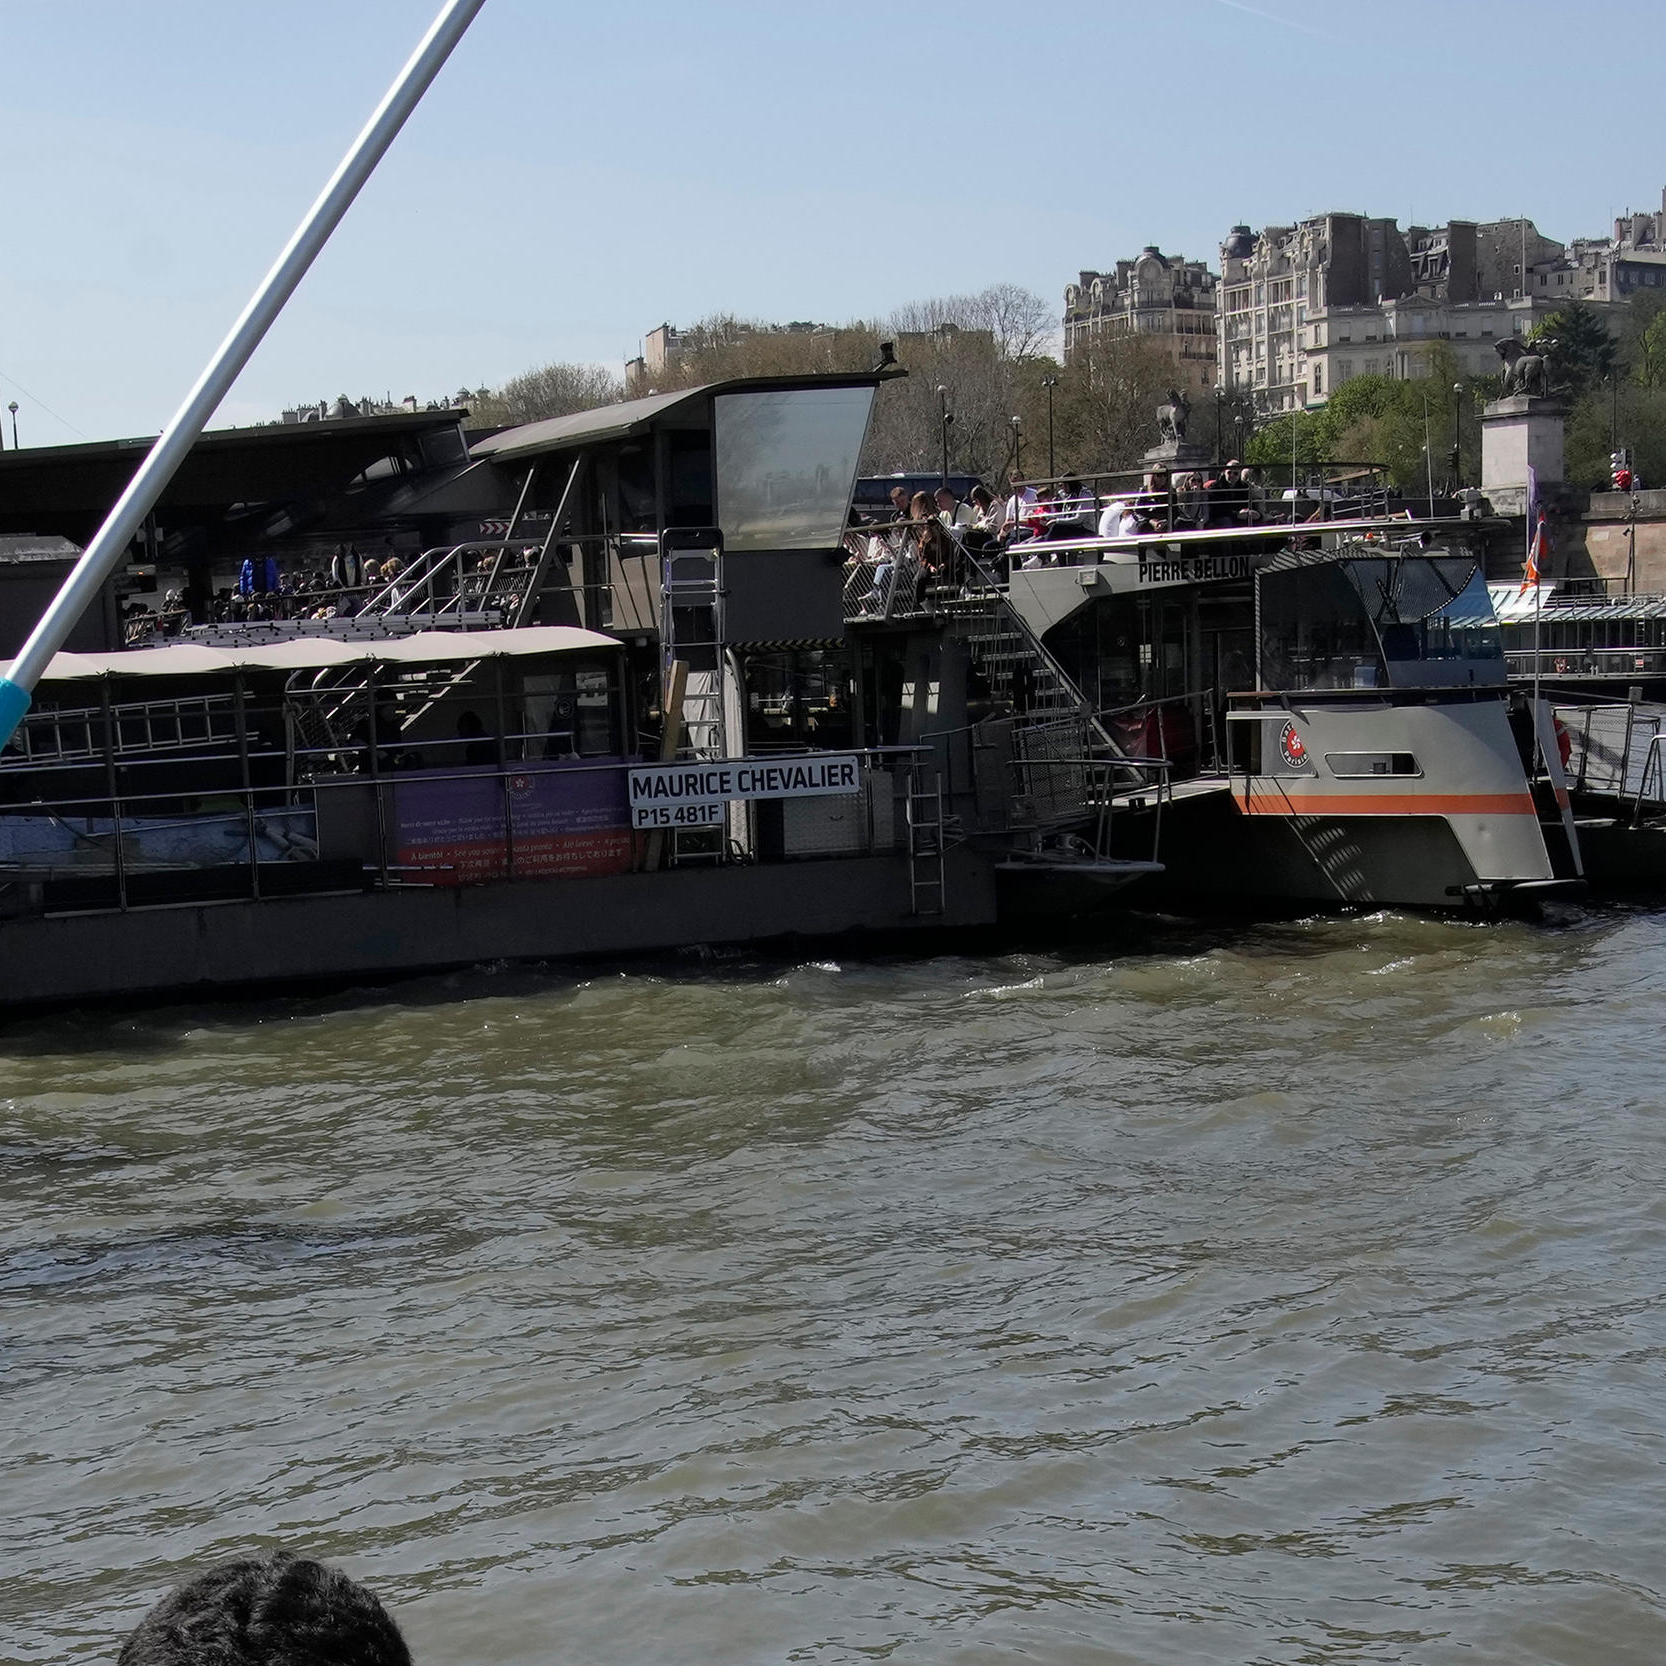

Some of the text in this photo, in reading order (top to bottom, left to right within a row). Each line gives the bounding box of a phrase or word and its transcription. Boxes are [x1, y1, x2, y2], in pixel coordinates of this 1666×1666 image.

[1139, 556, 1250, 583] PIERRE BELLON
[633, 763, 855, 800] MAURICE CHEVALIER
[638, 808, 671, 826] P15
[674, 804, 720, 824] 481F
